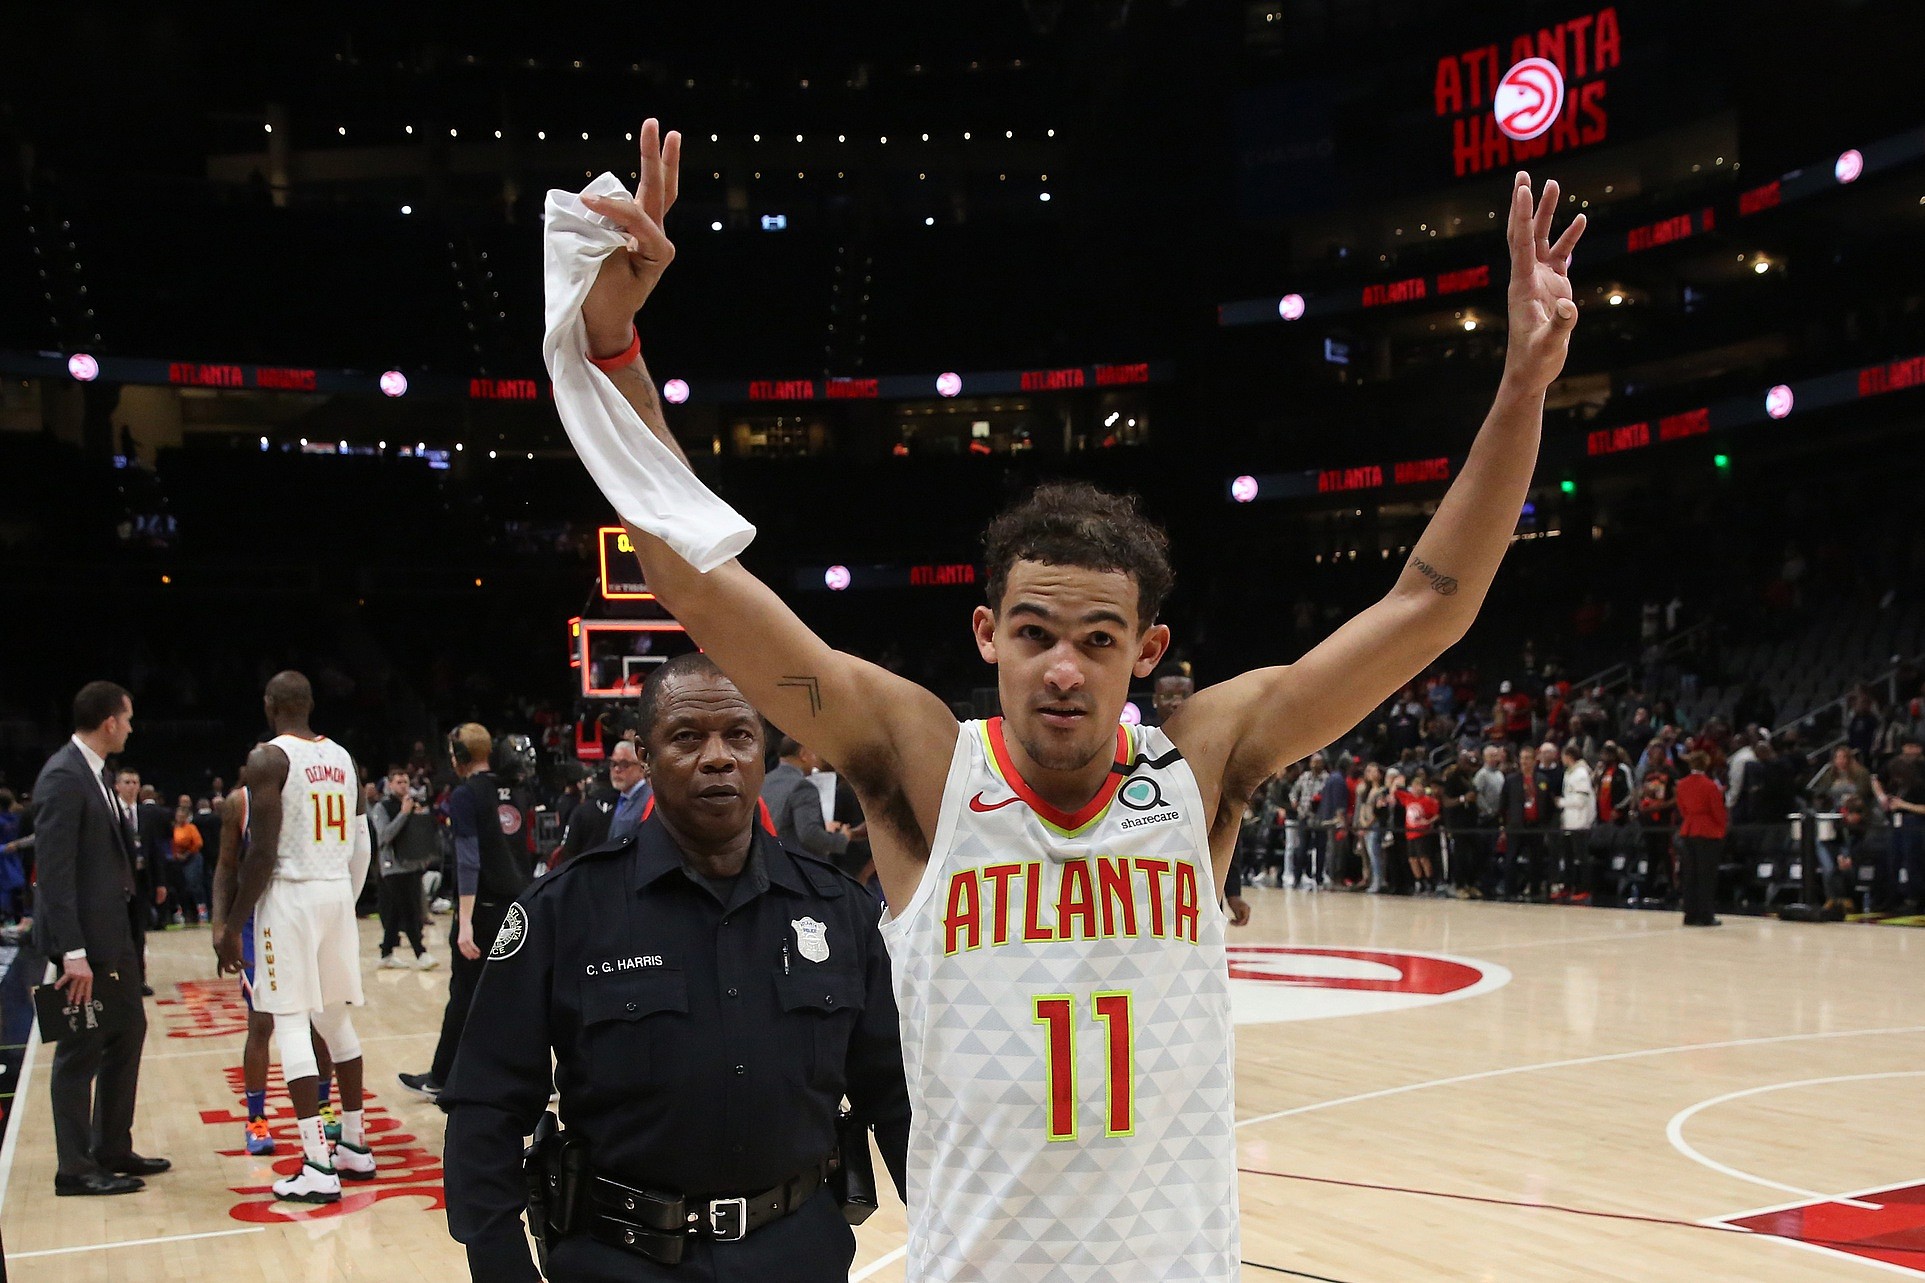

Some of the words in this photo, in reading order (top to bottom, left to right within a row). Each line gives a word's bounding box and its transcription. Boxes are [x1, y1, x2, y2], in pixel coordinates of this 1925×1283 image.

[1452, 79, 1607, 178] HAKS
[169, 362, 243, 387] ATLANTA
[1020, 368, 1085, 391] ATLANTA
[470, 378, 537, 400] ATLANTA
[749, 379, 814, 401] ATLANTA
[1318, 464, 1383, 494] ATLANTA
[910, 563, 975, 586] ATLANTA
[305, 765, 346, 785] DEDMON
[310, 791, 348, 845] 14
[1121, 811, 1179, 829] sharecare
[941, 854, 1201, 958] ATLANTA
[263, 927, 277, 991] HAWKS
[586, 964, 599, 975] C.
[601, 962, 614, 973] G.
[617, 955, 663, 971] HARRIS
[1031, 990, 1135, 1142] 11
